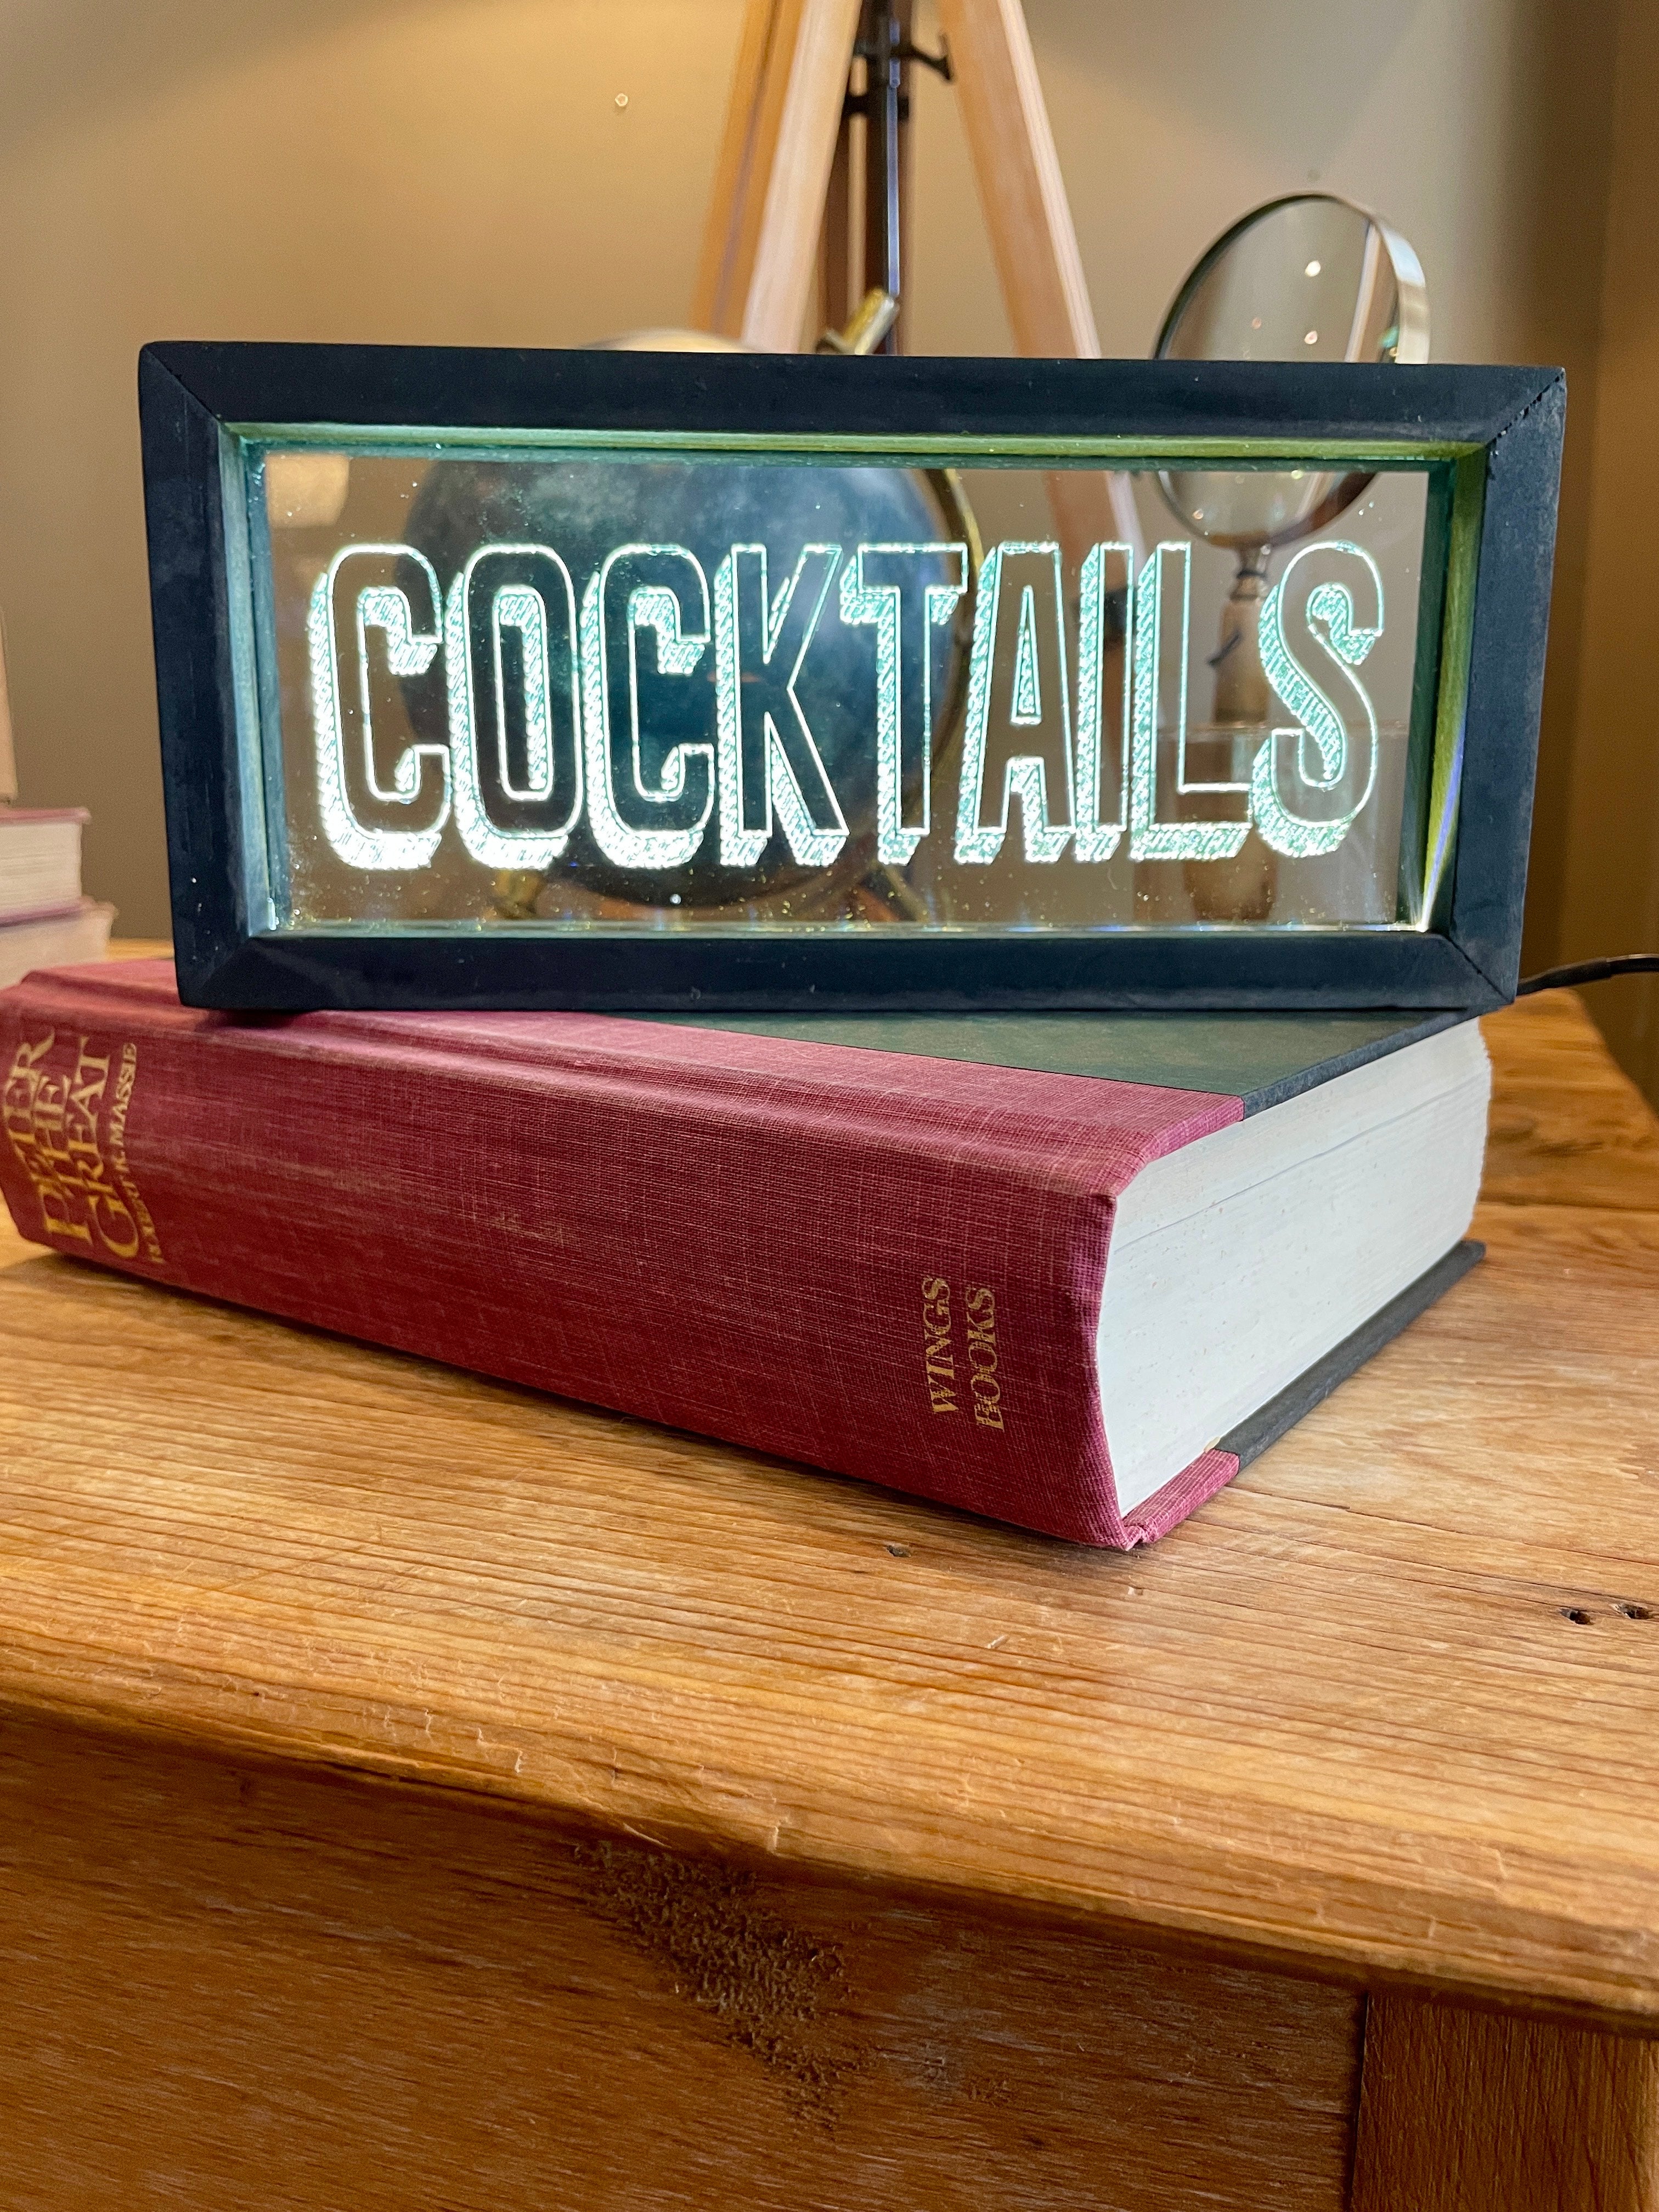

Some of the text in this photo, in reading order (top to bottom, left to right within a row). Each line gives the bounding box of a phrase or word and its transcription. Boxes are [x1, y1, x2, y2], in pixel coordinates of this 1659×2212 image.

[307, 540, 1386, 870] COCKTAILS
[69, 1036, 138, 1257] GREAT
[922, 1276, 958, 1412] WINGS
[966, 1287, 1005, 1433] BOOKS
